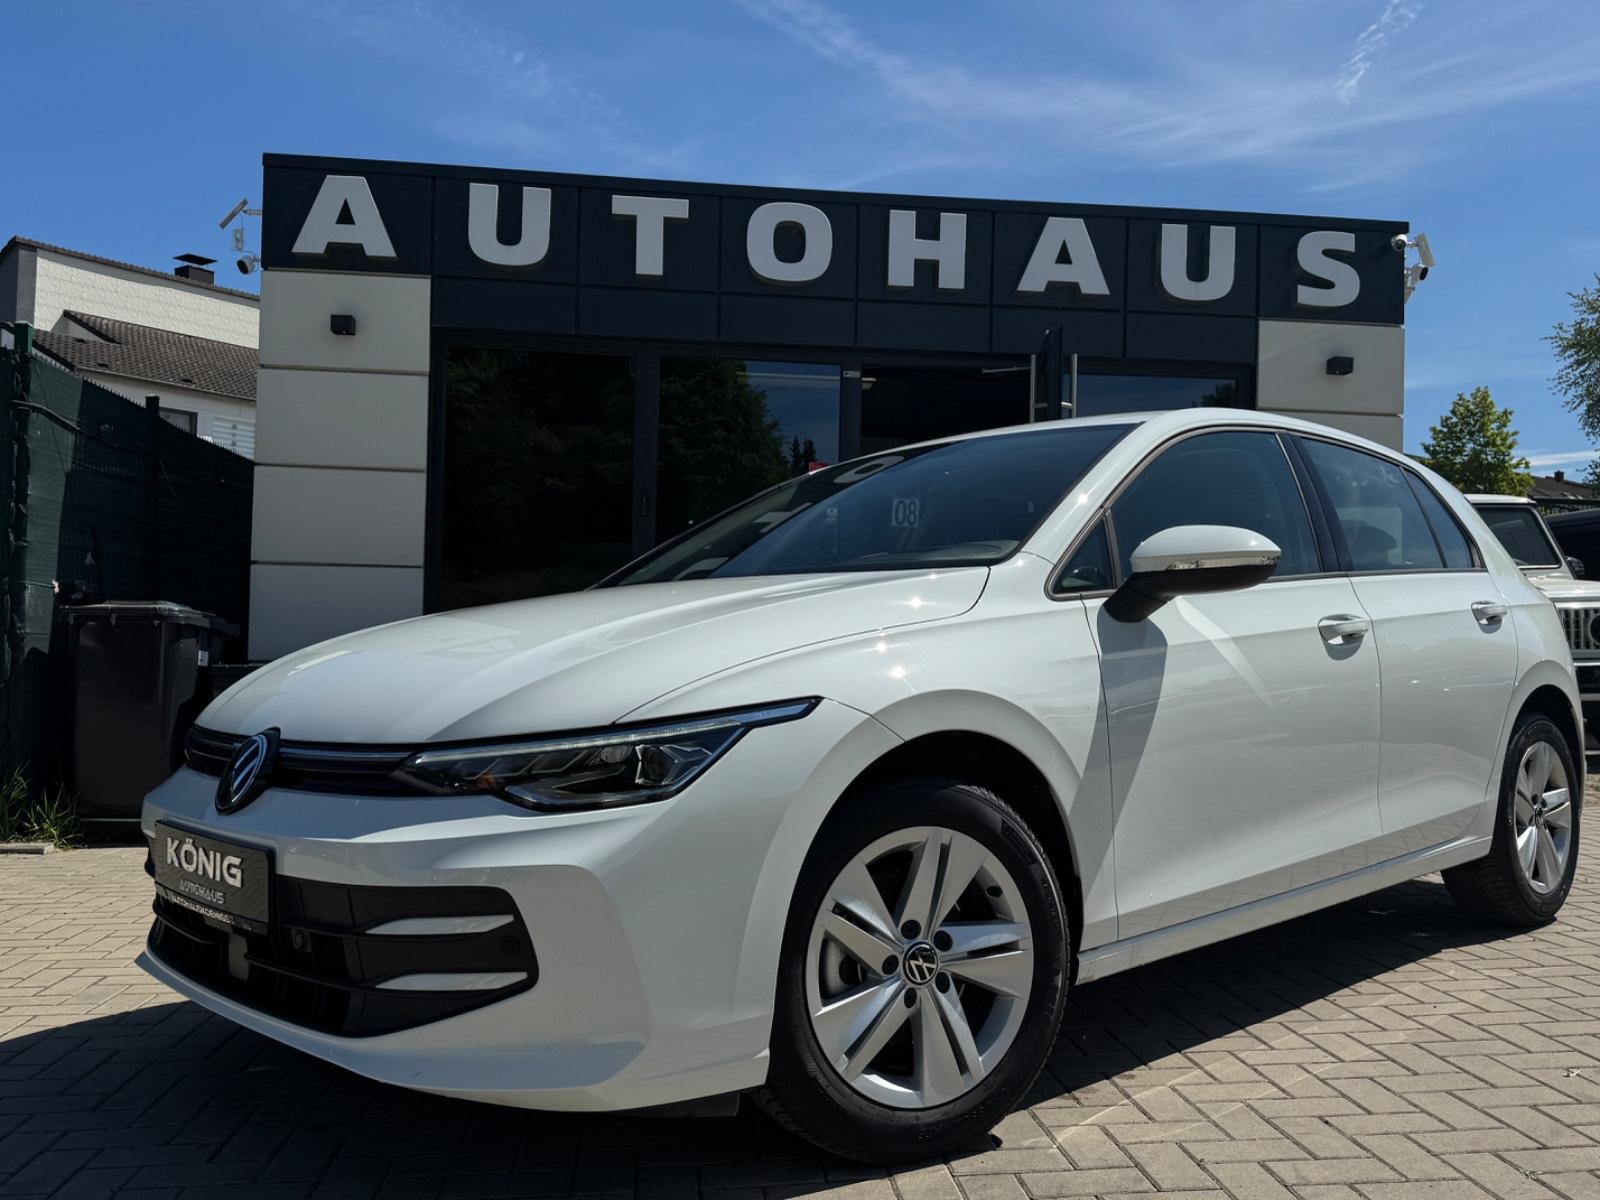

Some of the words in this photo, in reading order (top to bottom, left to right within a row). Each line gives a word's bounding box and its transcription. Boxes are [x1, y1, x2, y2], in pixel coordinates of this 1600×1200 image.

[291, 174, 1362, 308] AUTOHAUS
[894, 499, 918, 526] 08
[166, 837, 242, 888] KÖNIG
